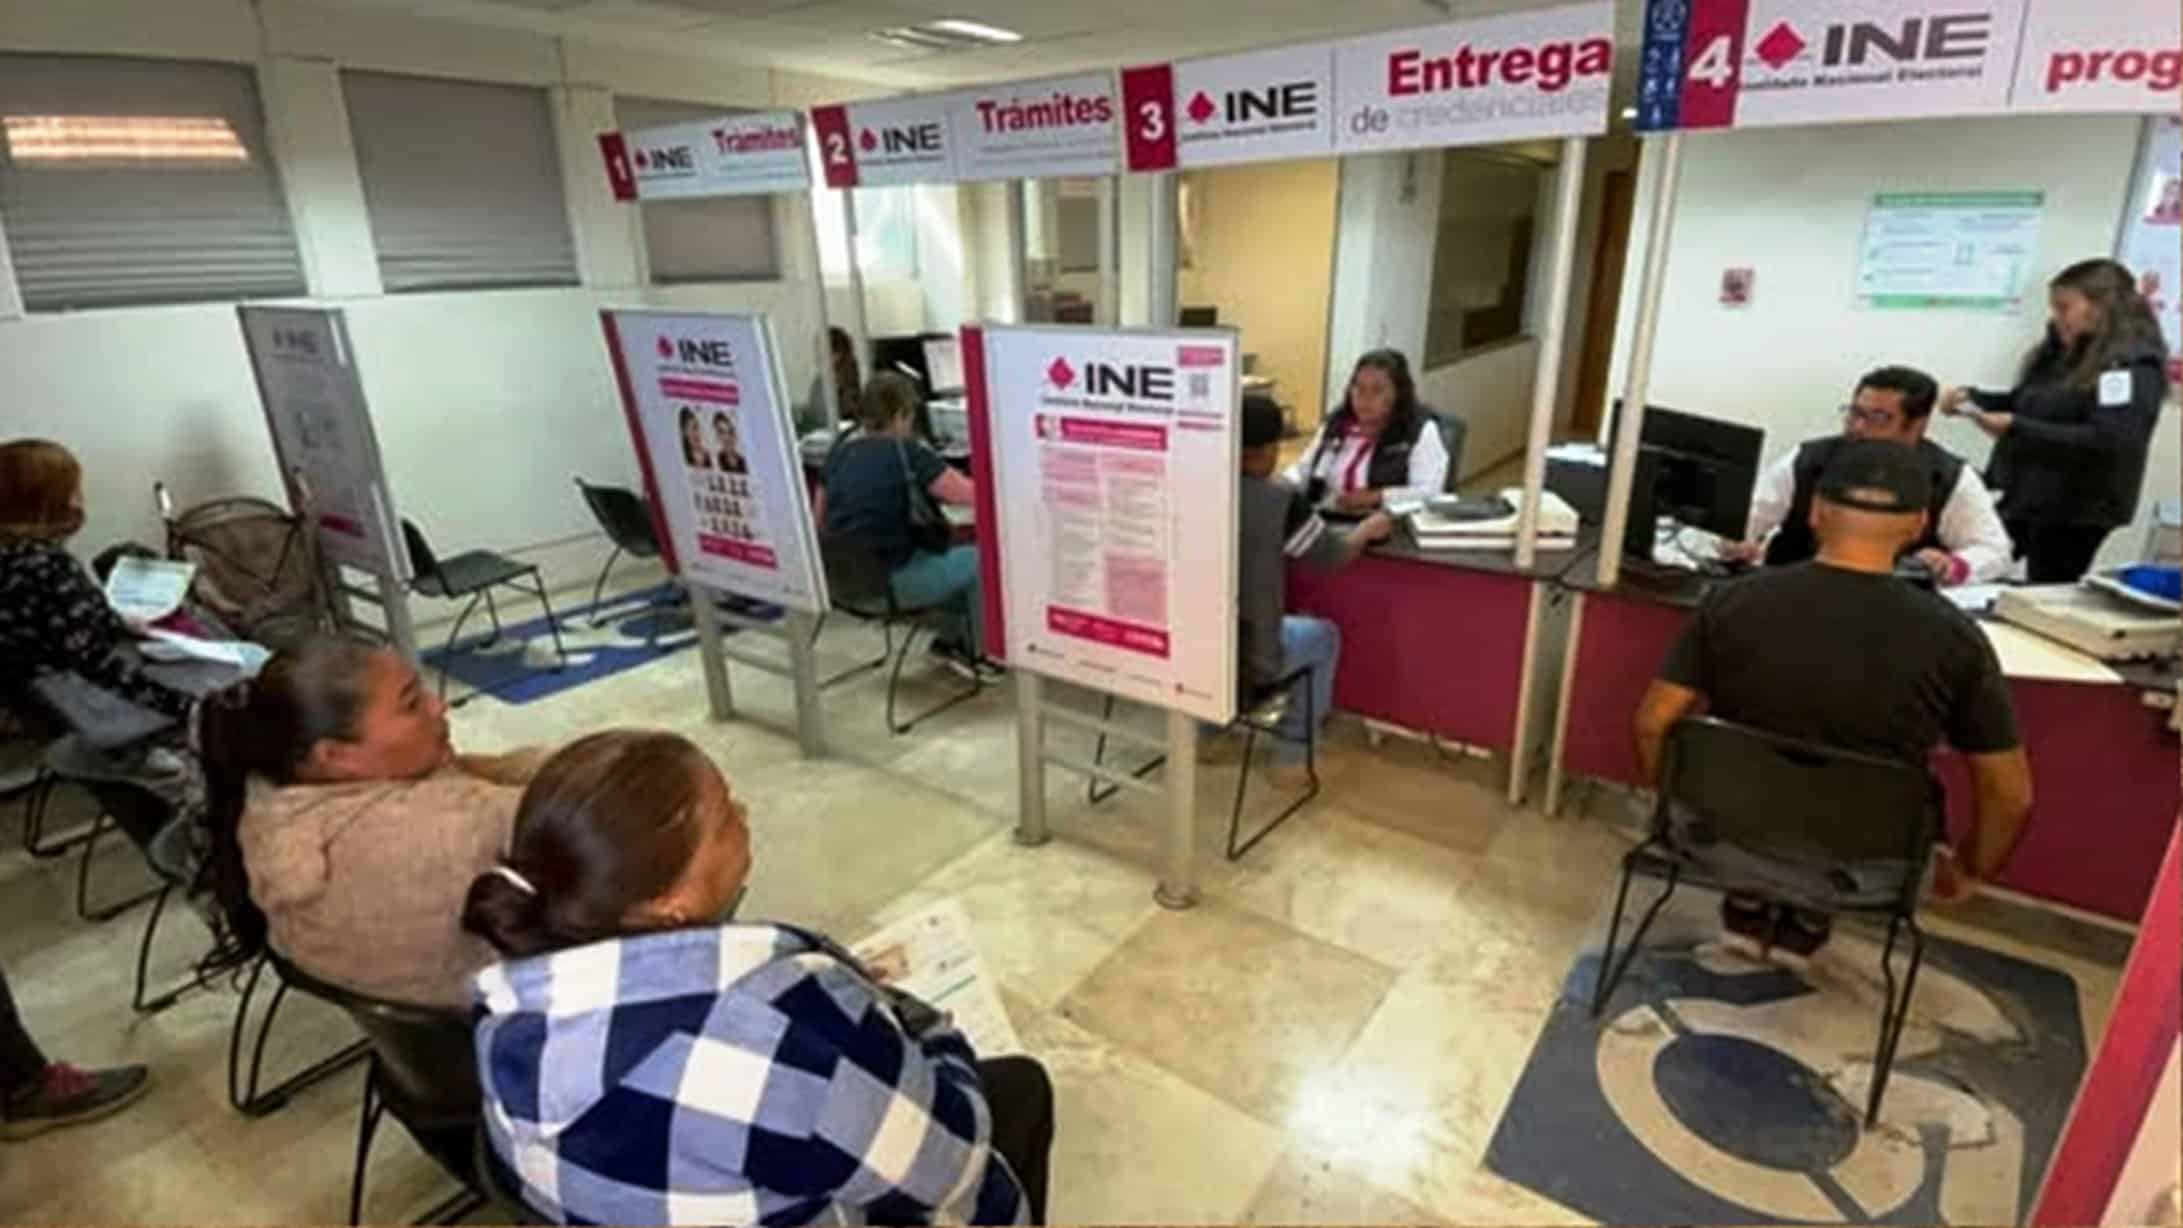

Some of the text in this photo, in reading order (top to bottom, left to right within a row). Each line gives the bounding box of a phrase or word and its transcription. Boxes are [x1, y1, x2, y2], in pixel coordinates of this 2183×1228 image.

[1823, 13, 1991, 67] INE
[1387, 37, 1612, 97] Entrega
[1688, 35, 1733, 88] 4
[2045, 50, 2183, 93] prog
[976, 92, 1113, 134] Trámites
[1139, 101, 1166, 140] 3
[1225, 81, 1317, 123] INE
[1351, 104, 1389, 135] de
[827, 133, 849, 165] 2
[882, 123, 942, 153] INE
[614, 155, 628, 181] 1
[651, 146, 694, 170] INE
[677, 338, 732, 367] INE
[1085, 362, 1174, 400] INE
